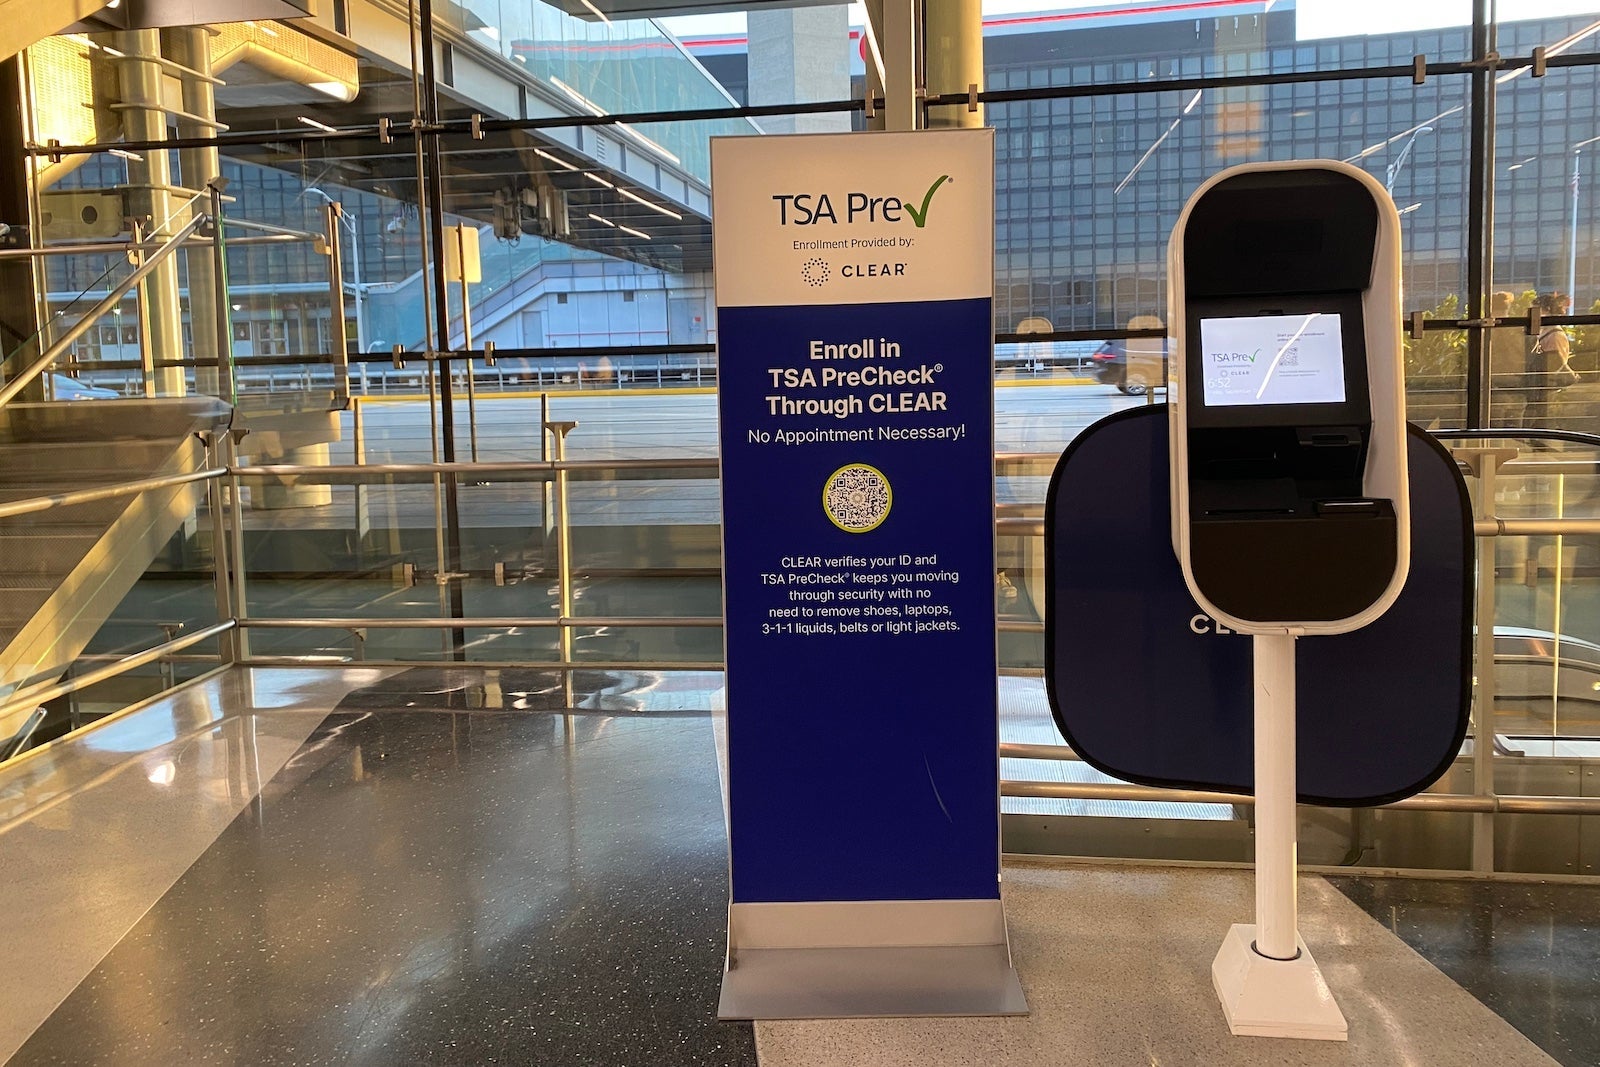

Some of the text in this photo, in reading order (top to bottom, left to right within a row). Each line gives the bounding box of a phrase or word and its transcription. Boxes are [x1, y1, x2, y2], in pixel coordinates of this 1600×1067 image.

[772, 193, 837, 226] TSA
[793, 236, 914, 250] Enrollment Provided by:
[841, 263, 905, 277] CLEAR
[810, 338, 900, 360] Enroll in
[1212, 353, 1230, 362] TSA
[768, 368, 816, 388] TSA
[765, 392, 947, 418] Through CLEAR
[748, 424, 966, 445] No Appointment Necessary!
[781, 554, 937, 568] CLEAR verifies your ID and
[761, 574, 785, 585] TSA
[853, 572, 888, 585] keeps
[891, 573, 912, 585] you
[916, 570, 959, 583] moving
[789, 588, 931, 603] through security with no
[769, 604, 952, 618] need to remove shoes, laptops,
[762, 621, 960, 636] 3-1-1 liquids, belts or light jackets.
